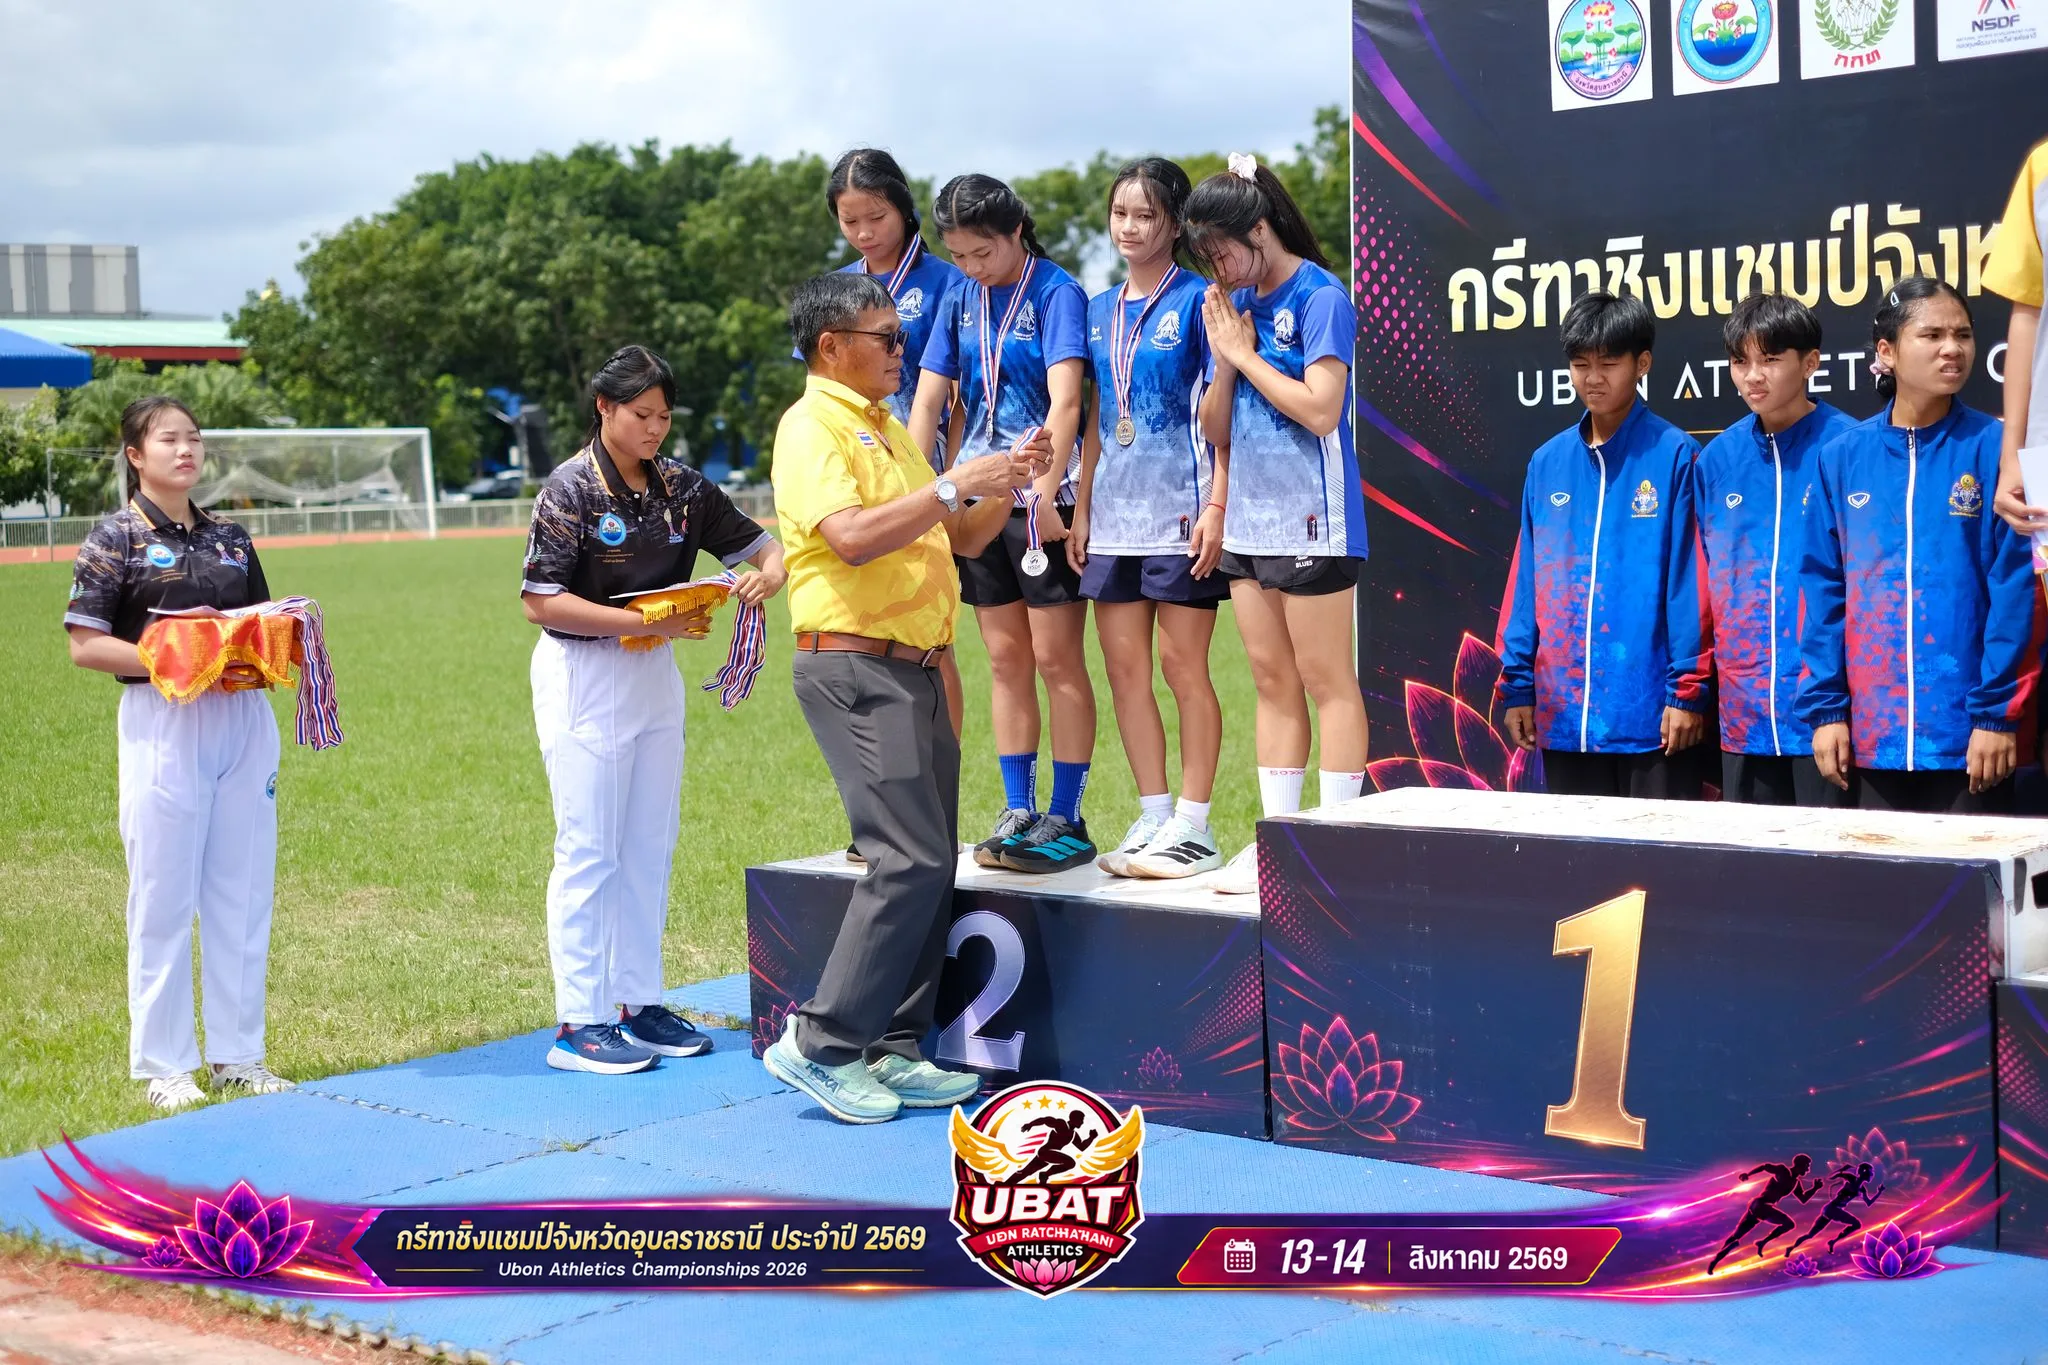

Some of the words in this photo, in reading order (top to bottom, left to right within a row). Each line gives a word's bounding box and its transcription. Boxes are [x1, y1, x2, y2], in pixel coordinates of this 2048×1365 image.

[1972, 14, 2020, 32] NSDF
[1834, 49, 1881, 68] กกท
[1518, 369, 1648, 407] UBN
[936, 911, 1026, 1072] 2
[1545, 890, 1647, 1149] 1
